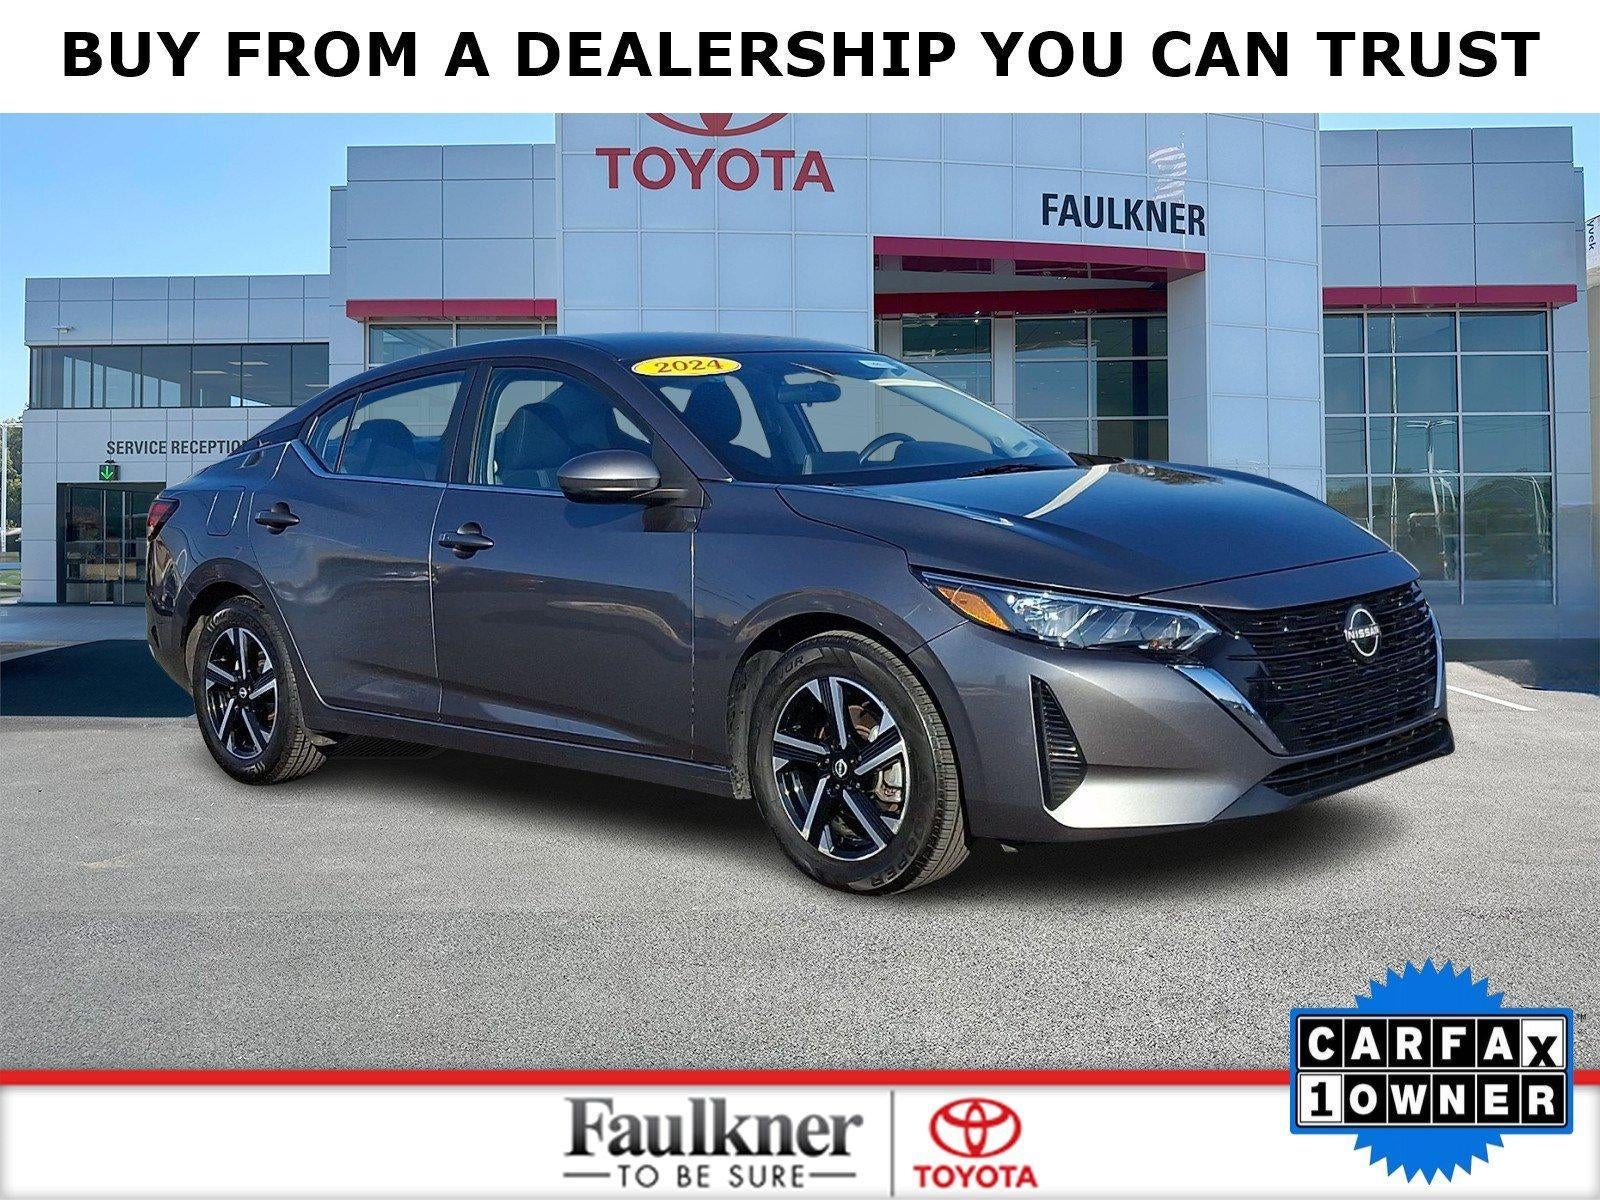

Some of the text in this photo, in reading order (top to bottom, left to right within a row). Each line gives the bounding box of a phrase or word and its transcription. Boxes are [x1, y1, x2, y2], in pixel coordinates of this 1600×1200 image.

[595, 146, 835, 192] TOYOTA
[1041, 193, 1206, 237] FAULKNER
[653, 359, 723, 373] 2024
[106, 439, 247, 455] SERVICE RECEPTIO
[1347, 626, 1379, 640] NISSAN
